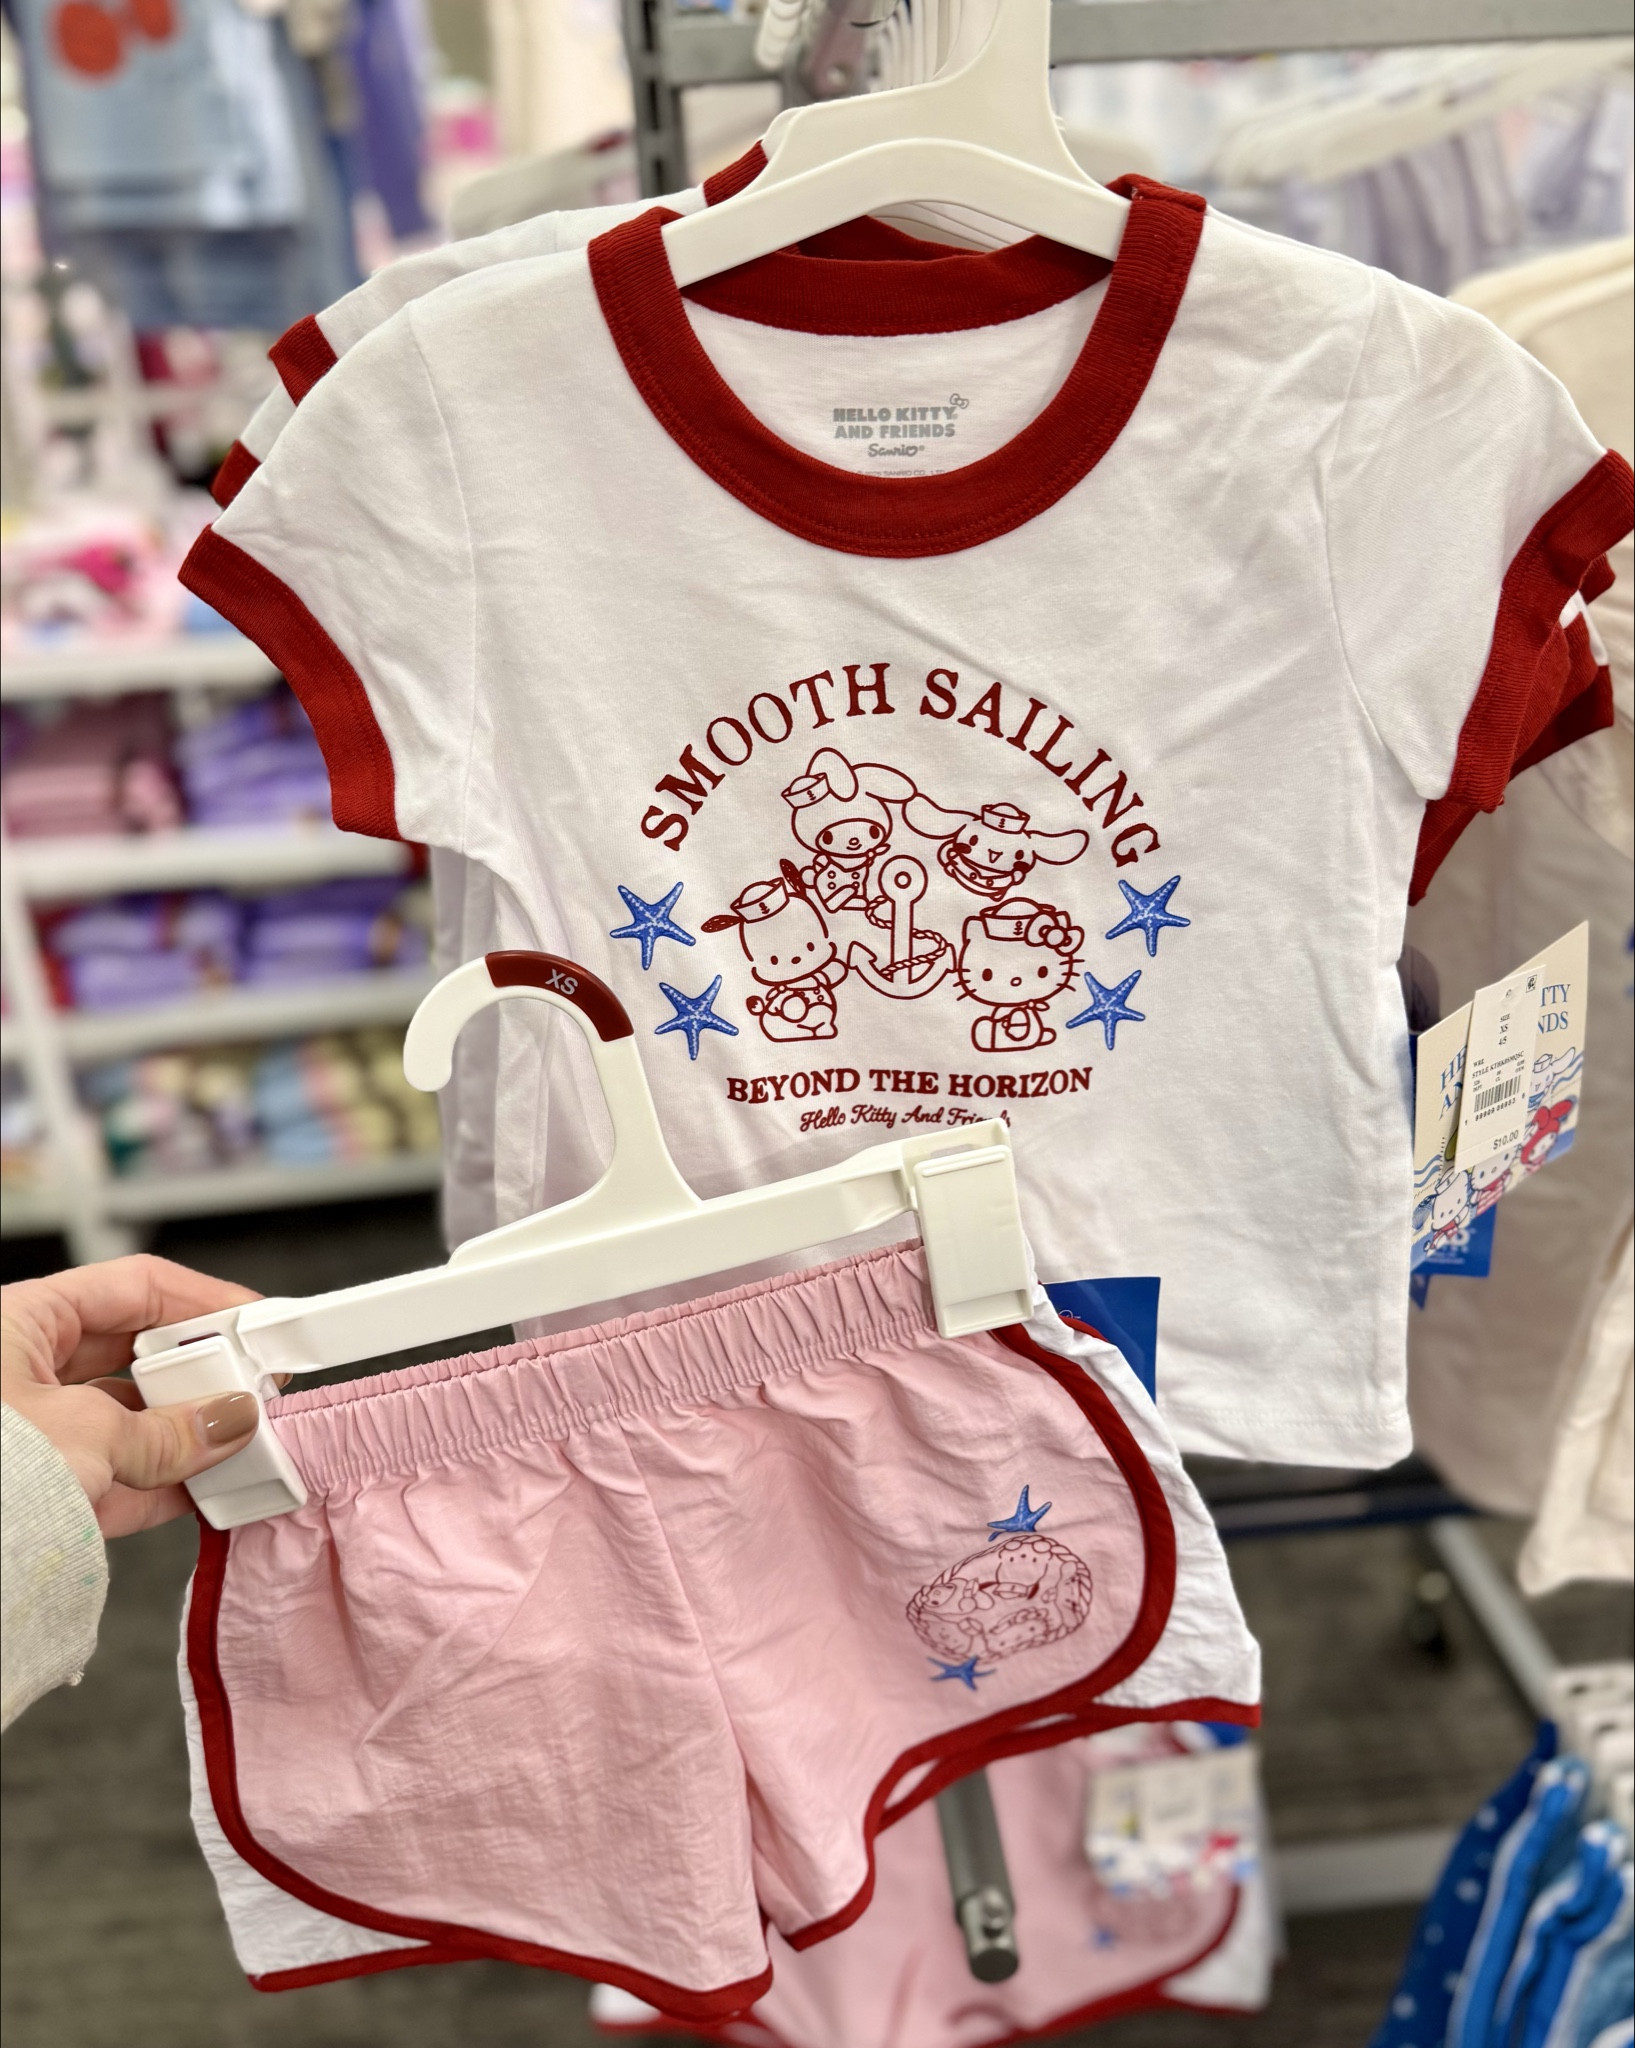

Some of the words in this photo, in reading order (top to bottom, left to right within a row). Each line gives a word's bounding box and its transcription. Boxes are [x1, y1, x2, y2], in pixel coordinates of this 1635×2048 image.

[833, 408, 892, 422] HELLO
[834, 425, 874, 439] AND
[880, 424, 956, 438] FRIENDS
[641, 663, 896, 851] SMOOTH
[919, 668, 1162, 868] SAILING
[545, 968, 579, 995] XS
[1472, 1063, 1489, 1079] STYLE
[726, 1068, 861, 1104] BEYOND
[869, 1069, 939, 1094] THE
[948, 1066, 1093, 1098] HORIZON
[799, 1107, 847, 1132] Hello
[850, 1104, 897, 1129] Kitty
[901, 1105, 944, 1125] And
[1493, 1129, 1519, 1150] $10.00
